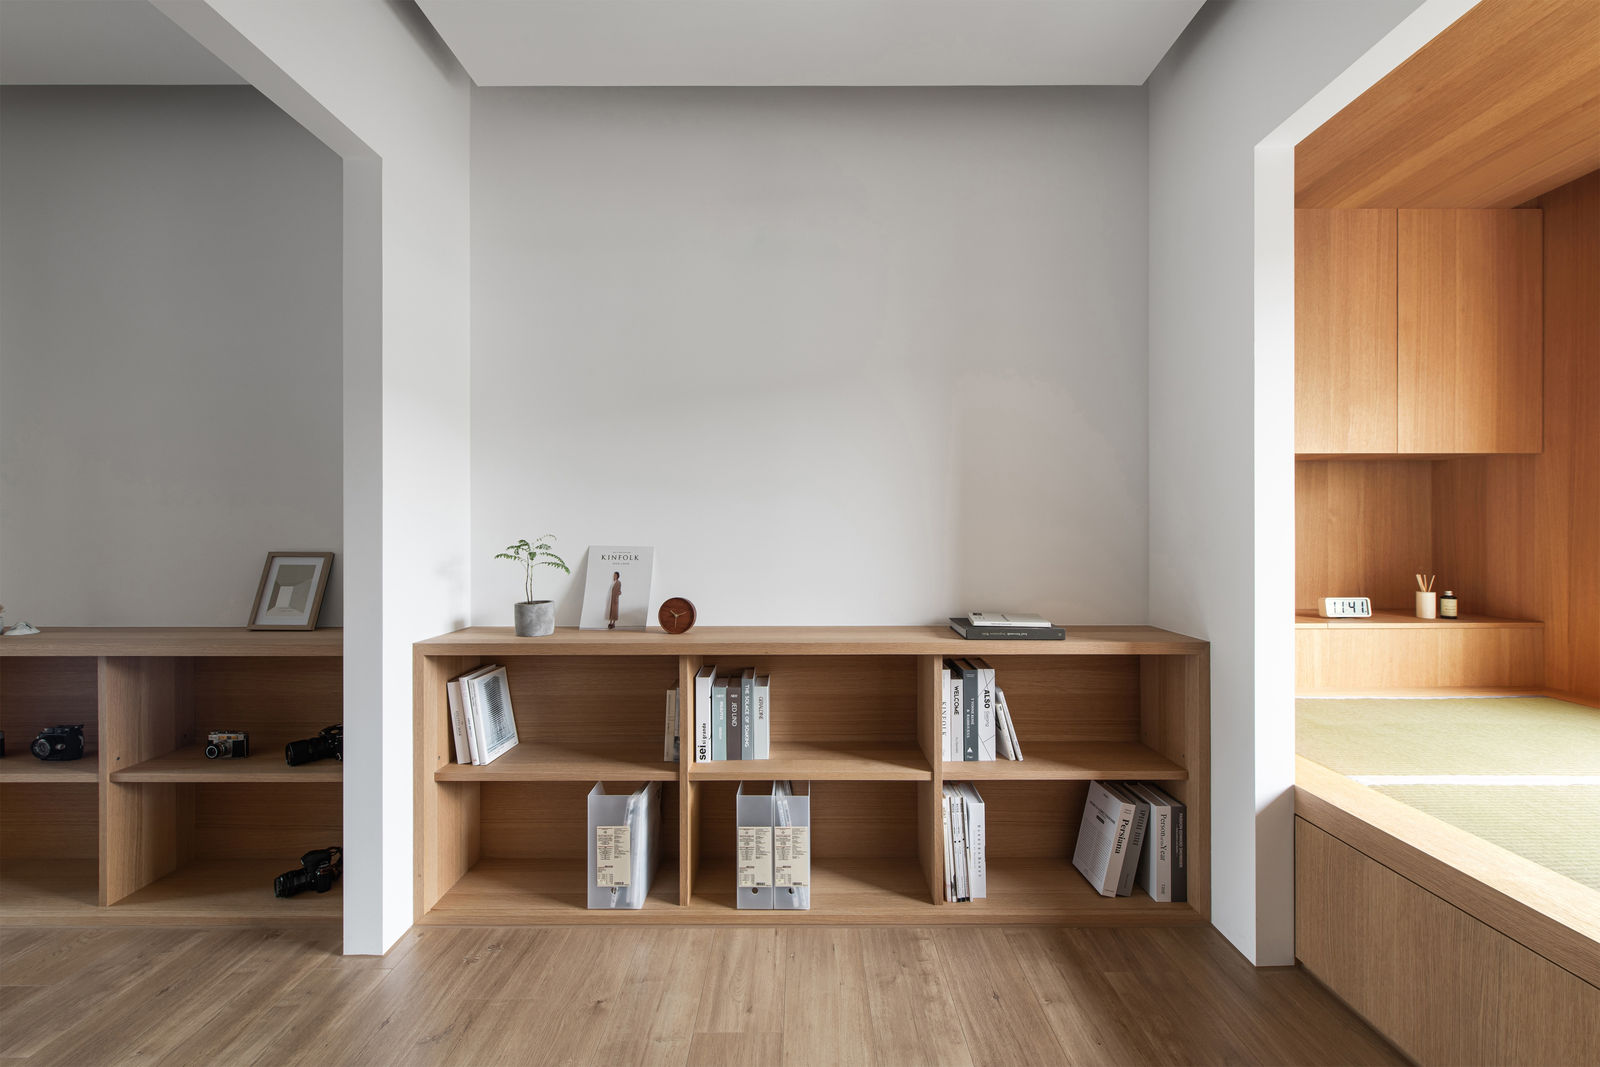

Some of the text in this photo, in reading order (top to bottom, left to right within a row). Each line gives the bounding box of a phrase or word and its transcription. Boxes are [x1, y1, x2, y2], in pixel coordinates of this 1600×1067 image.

[983, 689, 991, 709] ALSO
[745, 716, 751, 724] OF
[697, 744, 707, 760] sei
[1160, 813, 1168, 837] Person
[1114, 818, 1130, 854] Persiana
[1159, 844, 1169, 862] Year
